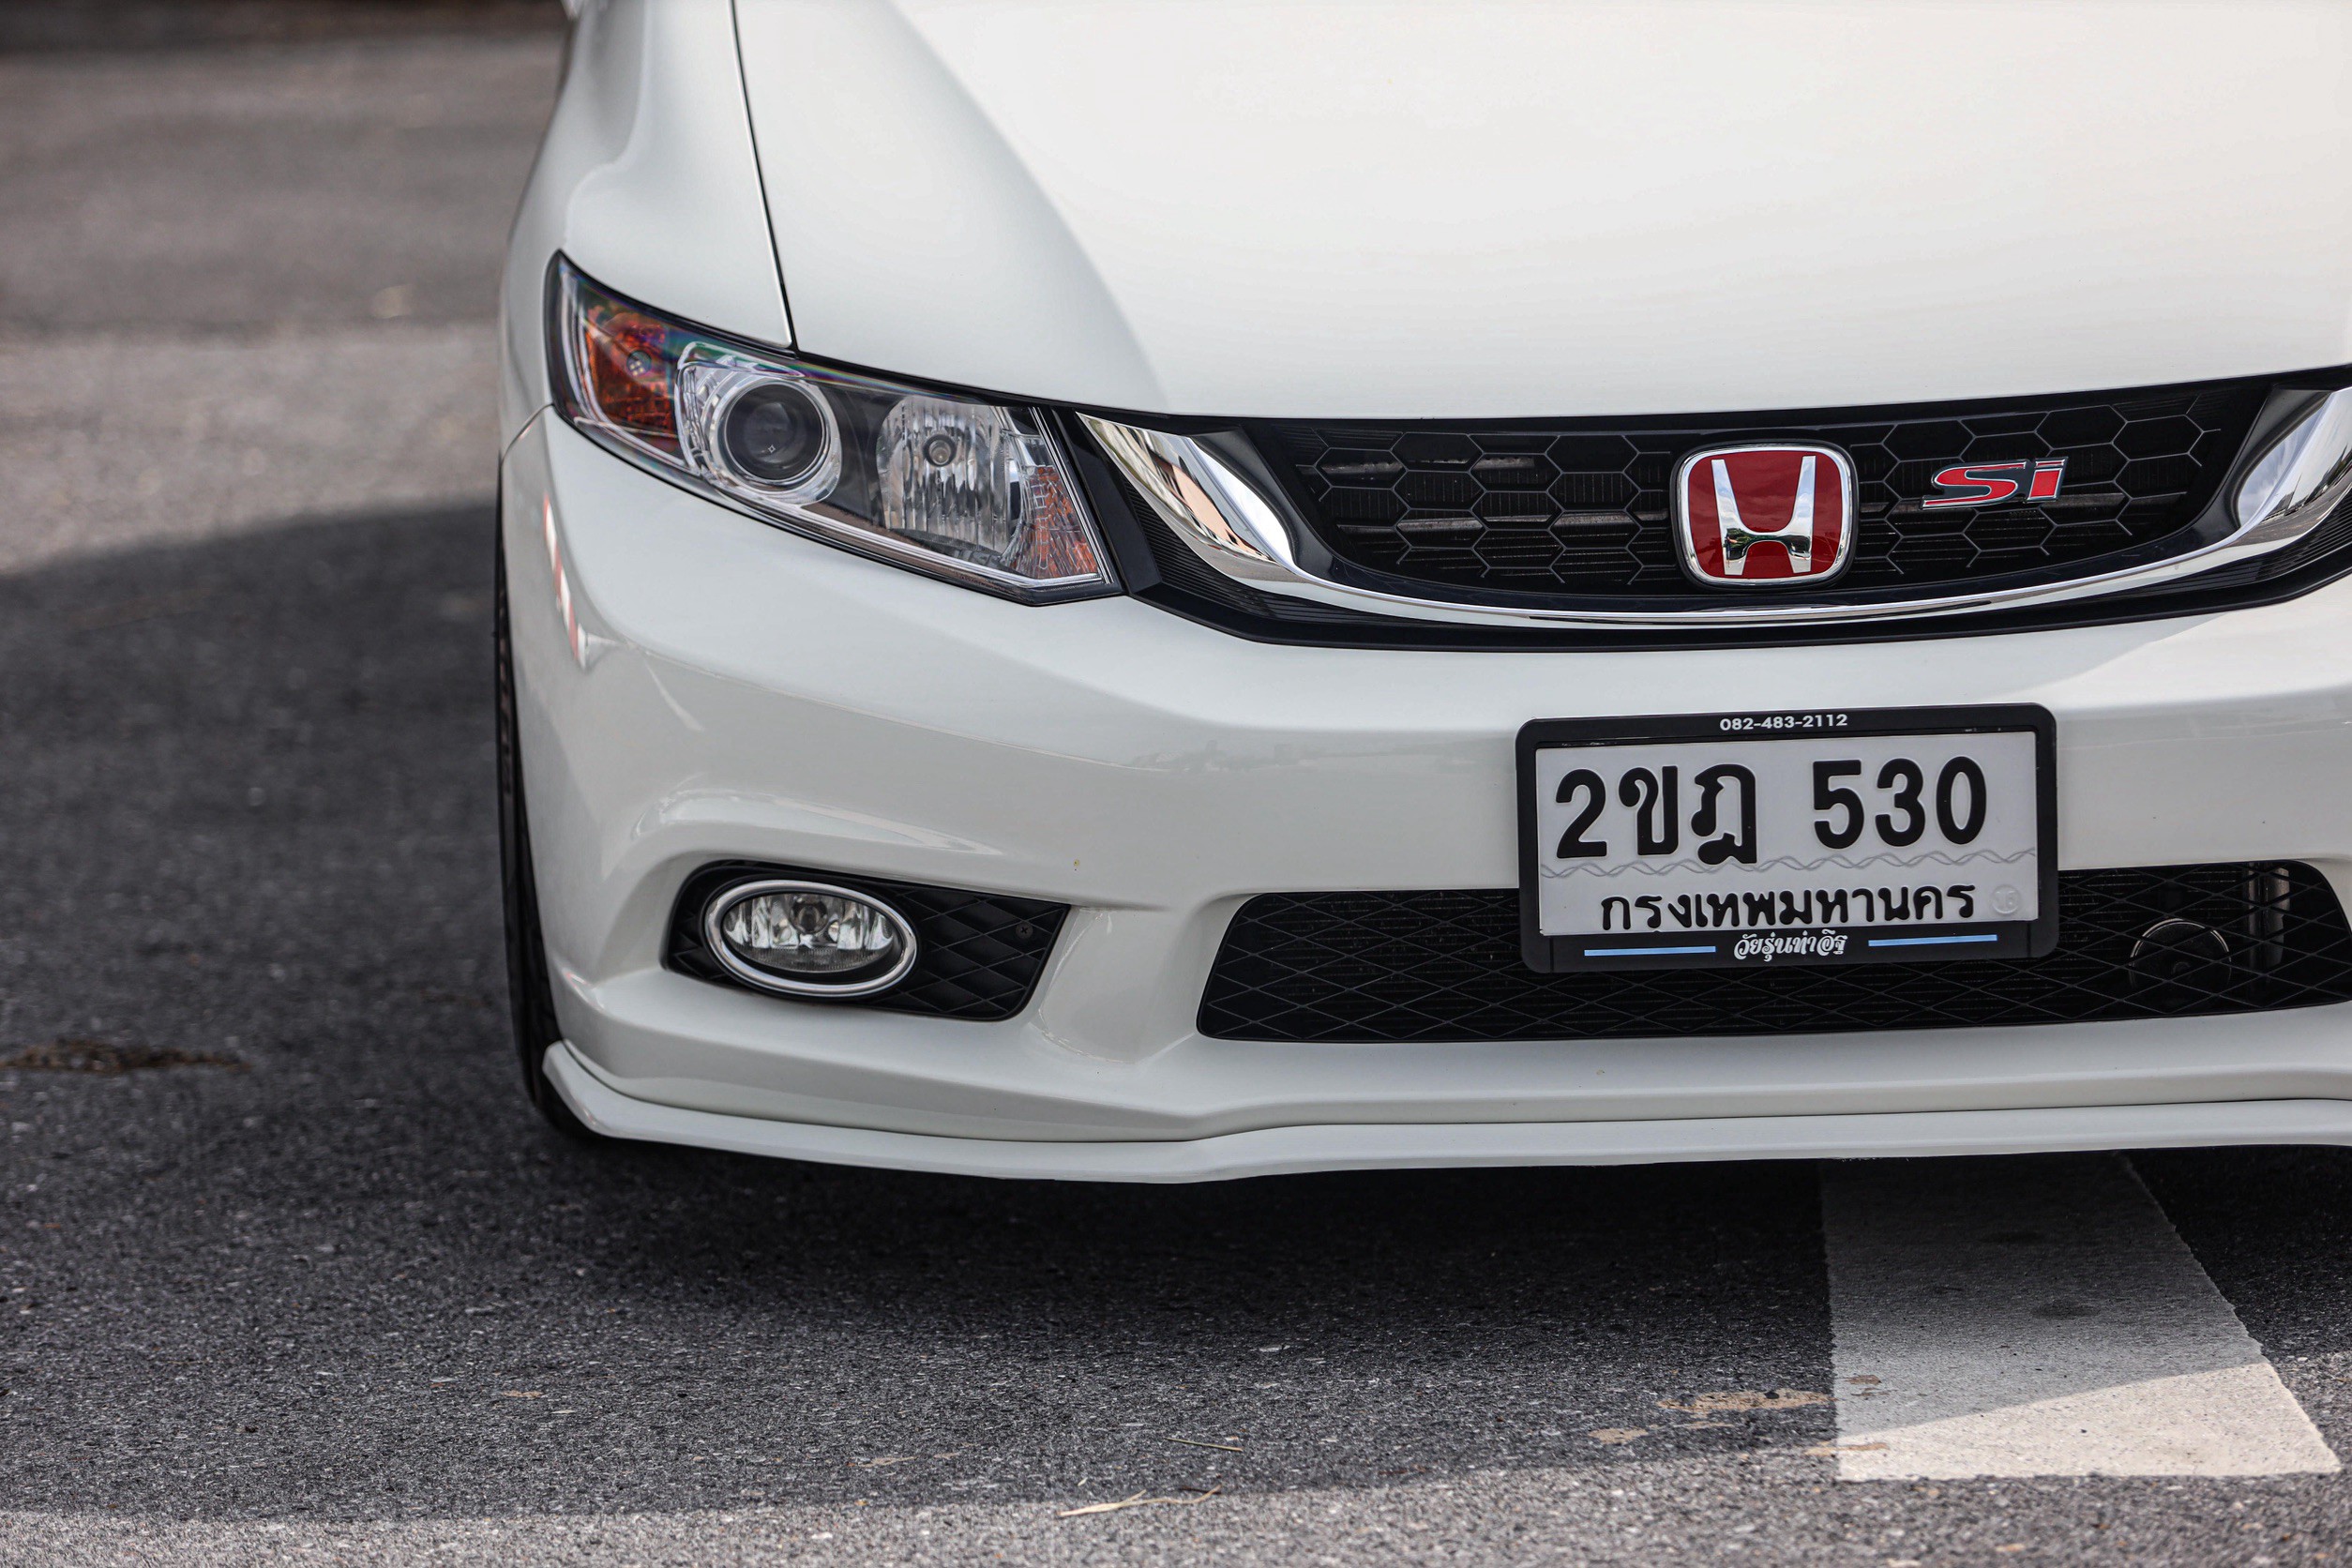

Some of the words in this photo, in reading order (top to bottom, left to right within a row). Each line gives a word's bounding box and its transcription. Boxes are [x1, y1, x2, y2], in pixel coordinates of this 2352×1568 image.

[1922, 458, 2067, 509] Si
[1719, 714, 1848, 731] 082-483-2112
[1555, 763, 1757, 866] 2ขฎ
[1812, 756, 1987, 850] 530
[1600, 884, 1976, 931] กรงเทพมหานคร
